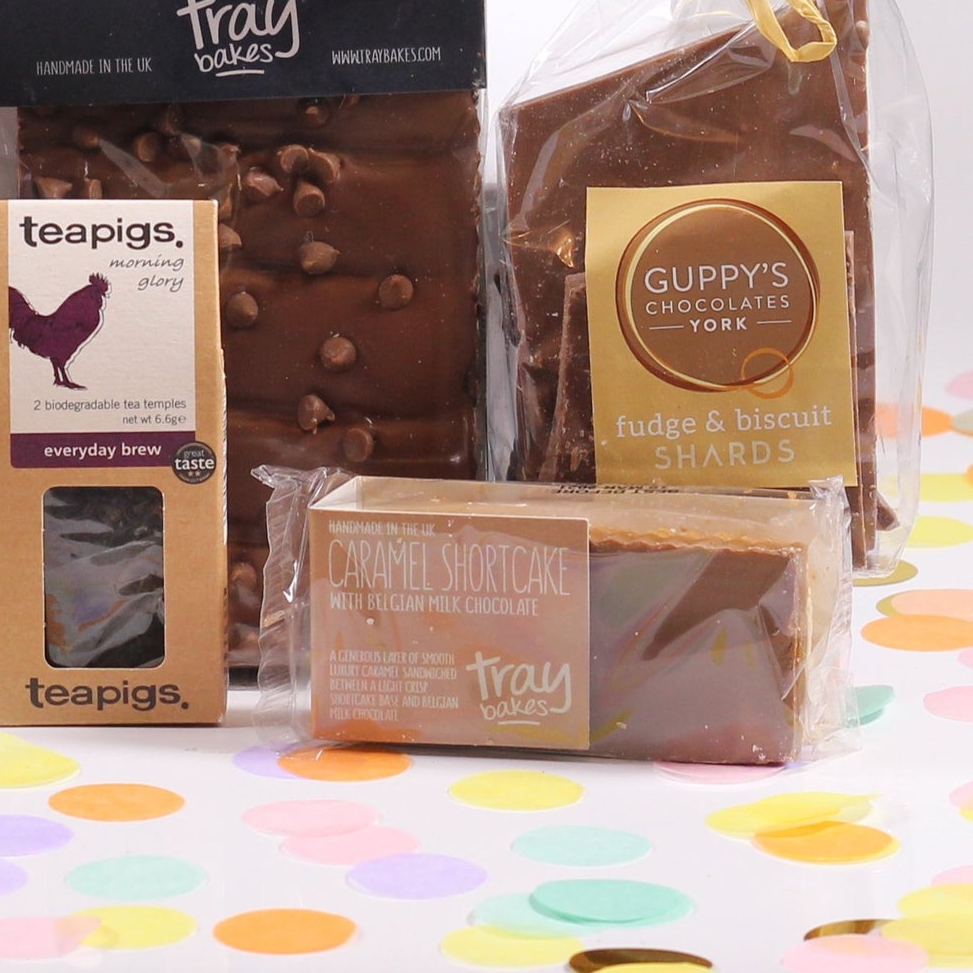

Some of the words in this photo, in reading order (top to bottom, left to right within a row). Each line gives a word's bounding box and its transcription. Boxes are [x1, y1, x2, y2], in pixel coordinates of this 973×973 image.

[36, 59, 96, 76] HANDMADE
[99, 58, 111, 74] IN
[115, 57, 134, 73] THE
[137, 57, 153, 72] UK
[194, 43, 273, 74] bakes
[19, 216, 184, 250] teapigs.
[109, 254, 185, 272] morning
[138, 275, 185, 293] glory
[645, 295, 790, 316] CHOCOLATES
[689, 317, 748, 333] YORK
[33, 400, 41, 411] 2
[45, 398, 120, 413] biodegradable
[123, 400, 140, 410] tea
[144, 398, 187, 413] temples
[122, 415, 137, 424] net
[141, 415, 151, 424] wt
[616, 413, 697, 440] fudge
[705, 410, 725, 433] &
[735, 405, 832, 431] biscuit
[44, 443, 117, 460] everyday
[121, 443, 162, 457] brew
[654, 439, 796, 470] SHARDS
[175, 458, 215, 470] taste
[328, 520, 384, 536] HANDMADE
[386, 522, 398, 535] IN
[401, 522, 419, 537] THE
[421, 523, 436, 537] UK
[328, 538, 434, 591] CARAMEL
[442, 543, 571, 596] SHORTCAKE
[330, 592, 363, 611] WITH
[367, 593, 425, 613] BELGIAN
[428, 595, 461, 614] MILK
[465, 597, 539, 616] CHOCOLATE
[330, 650, 336, 662] A
[339, 650, 381, 663] GENEROUS
[383, 651, 407, 664] LAYER
[408, 652, 419, 664] OF
[422, 652, 455, 665] SMOOTH
[362, 665, 398, 678] CARAMEL
[402, 667, 457, 680] SANDWICHED
[465, 650, 572, 713] tray
[25, 677, 189, 711] teapigs.
[330, 678, 367, 692] BETWEEN
[378, 680, 402, 692] LIGHT
[378, 694, 398, 707] BASE
[402, 695, 420, 708] AND
[422, 695, 459, 709] BELGIAN
[480, 697, 548, 720] bakes
